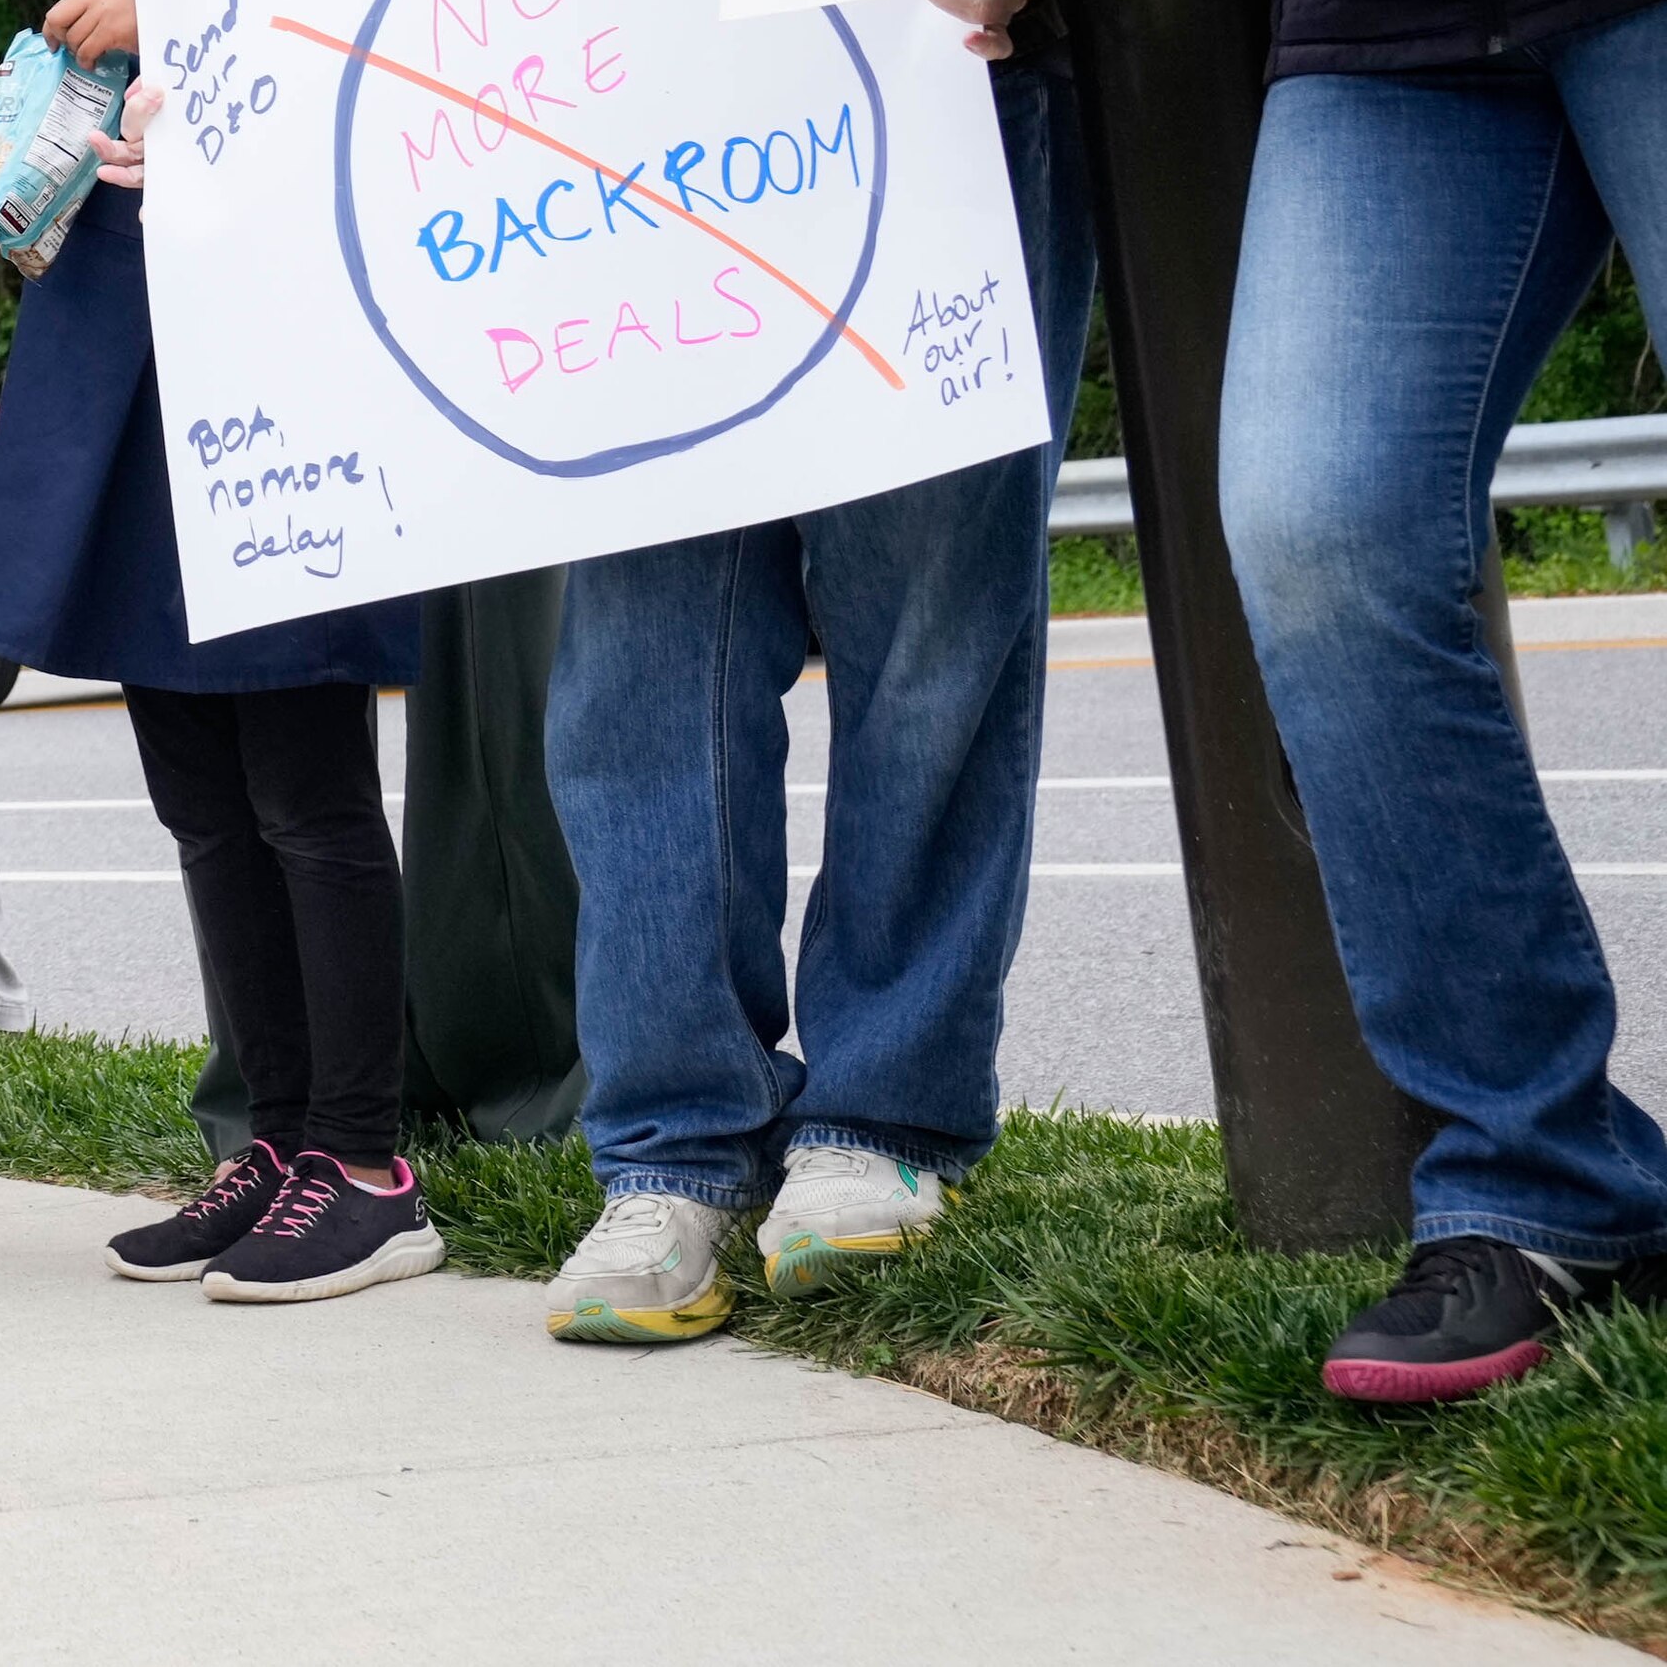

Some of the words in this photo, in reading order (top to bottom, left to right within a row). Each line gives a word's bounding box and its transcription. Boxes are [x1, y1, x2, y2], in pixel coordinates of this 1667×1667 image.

[92, 83, 113, 97] Facts
[186, 54, 237, 125] our
[401, 26, 628, 192] MORE
[417, 103, 862, 282] BACKROOM
[484, 265, 764, 394] DEALS
[901, 270, 1002, 356] About
[922, 319, 980, 375] our
[938, 329, 1016, 408] air!
